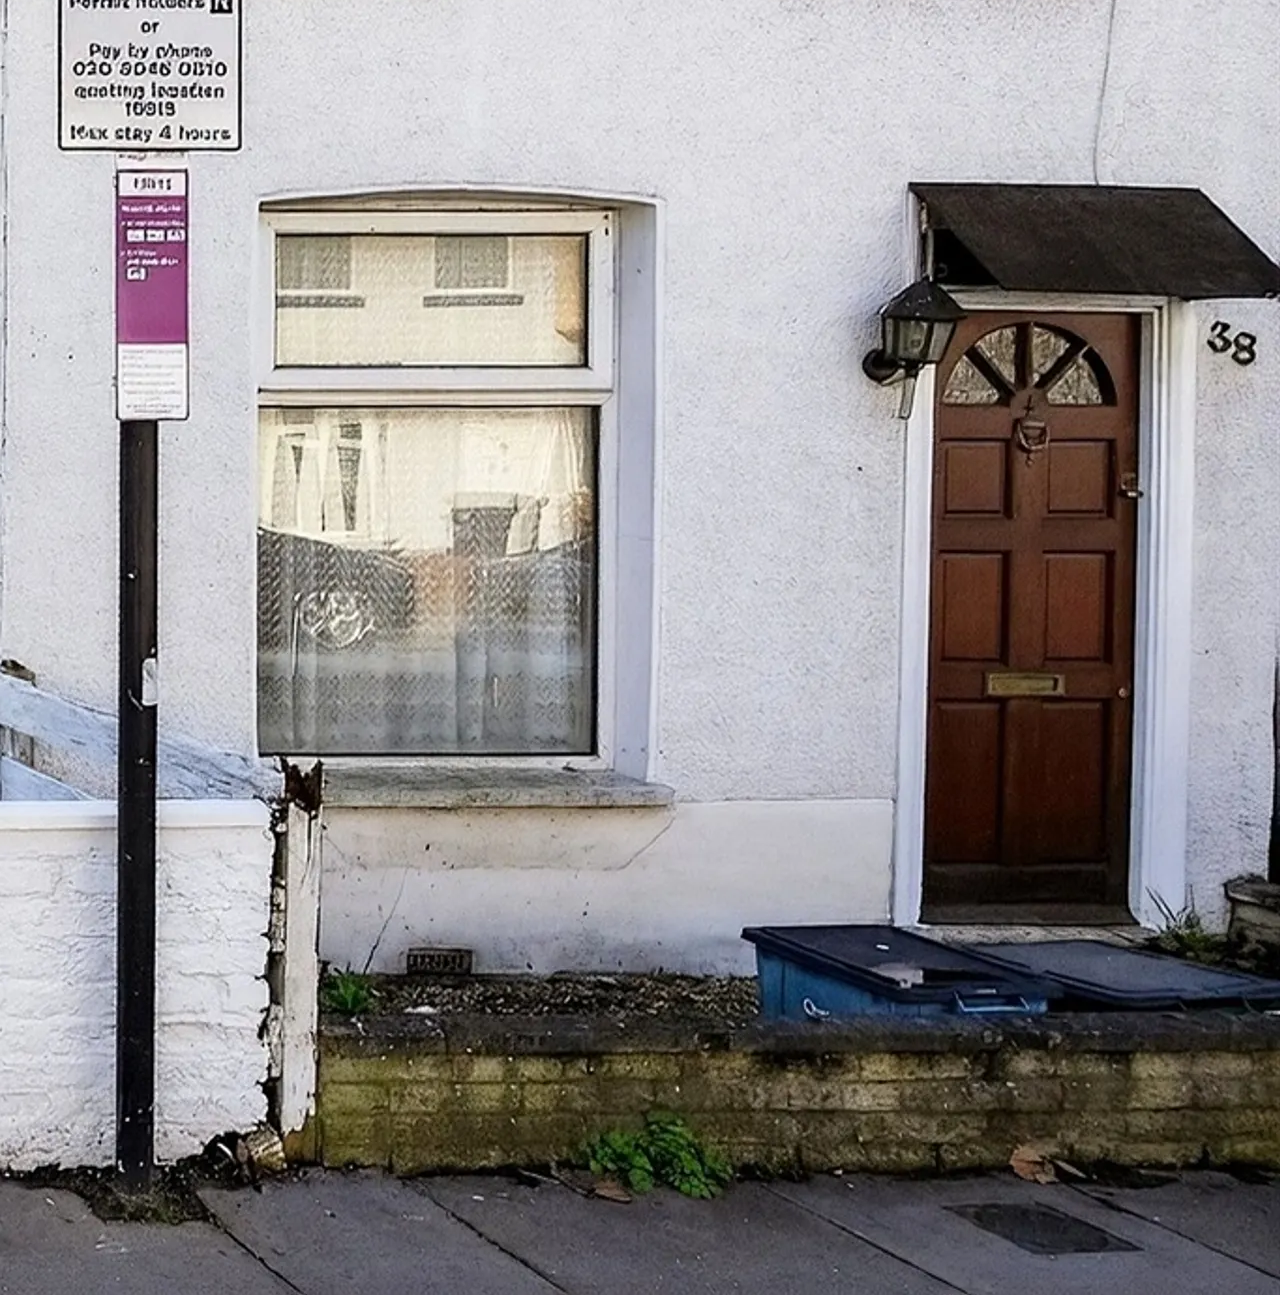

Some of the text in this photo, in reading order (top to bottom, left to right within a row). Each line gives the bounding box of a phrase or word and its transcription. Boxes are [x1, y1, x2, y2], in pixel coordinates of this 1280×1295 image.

[141, 22, 159, 33] or
[90, 43, 120, 60] Pay
[1207, 321, 1257, 365] 38
